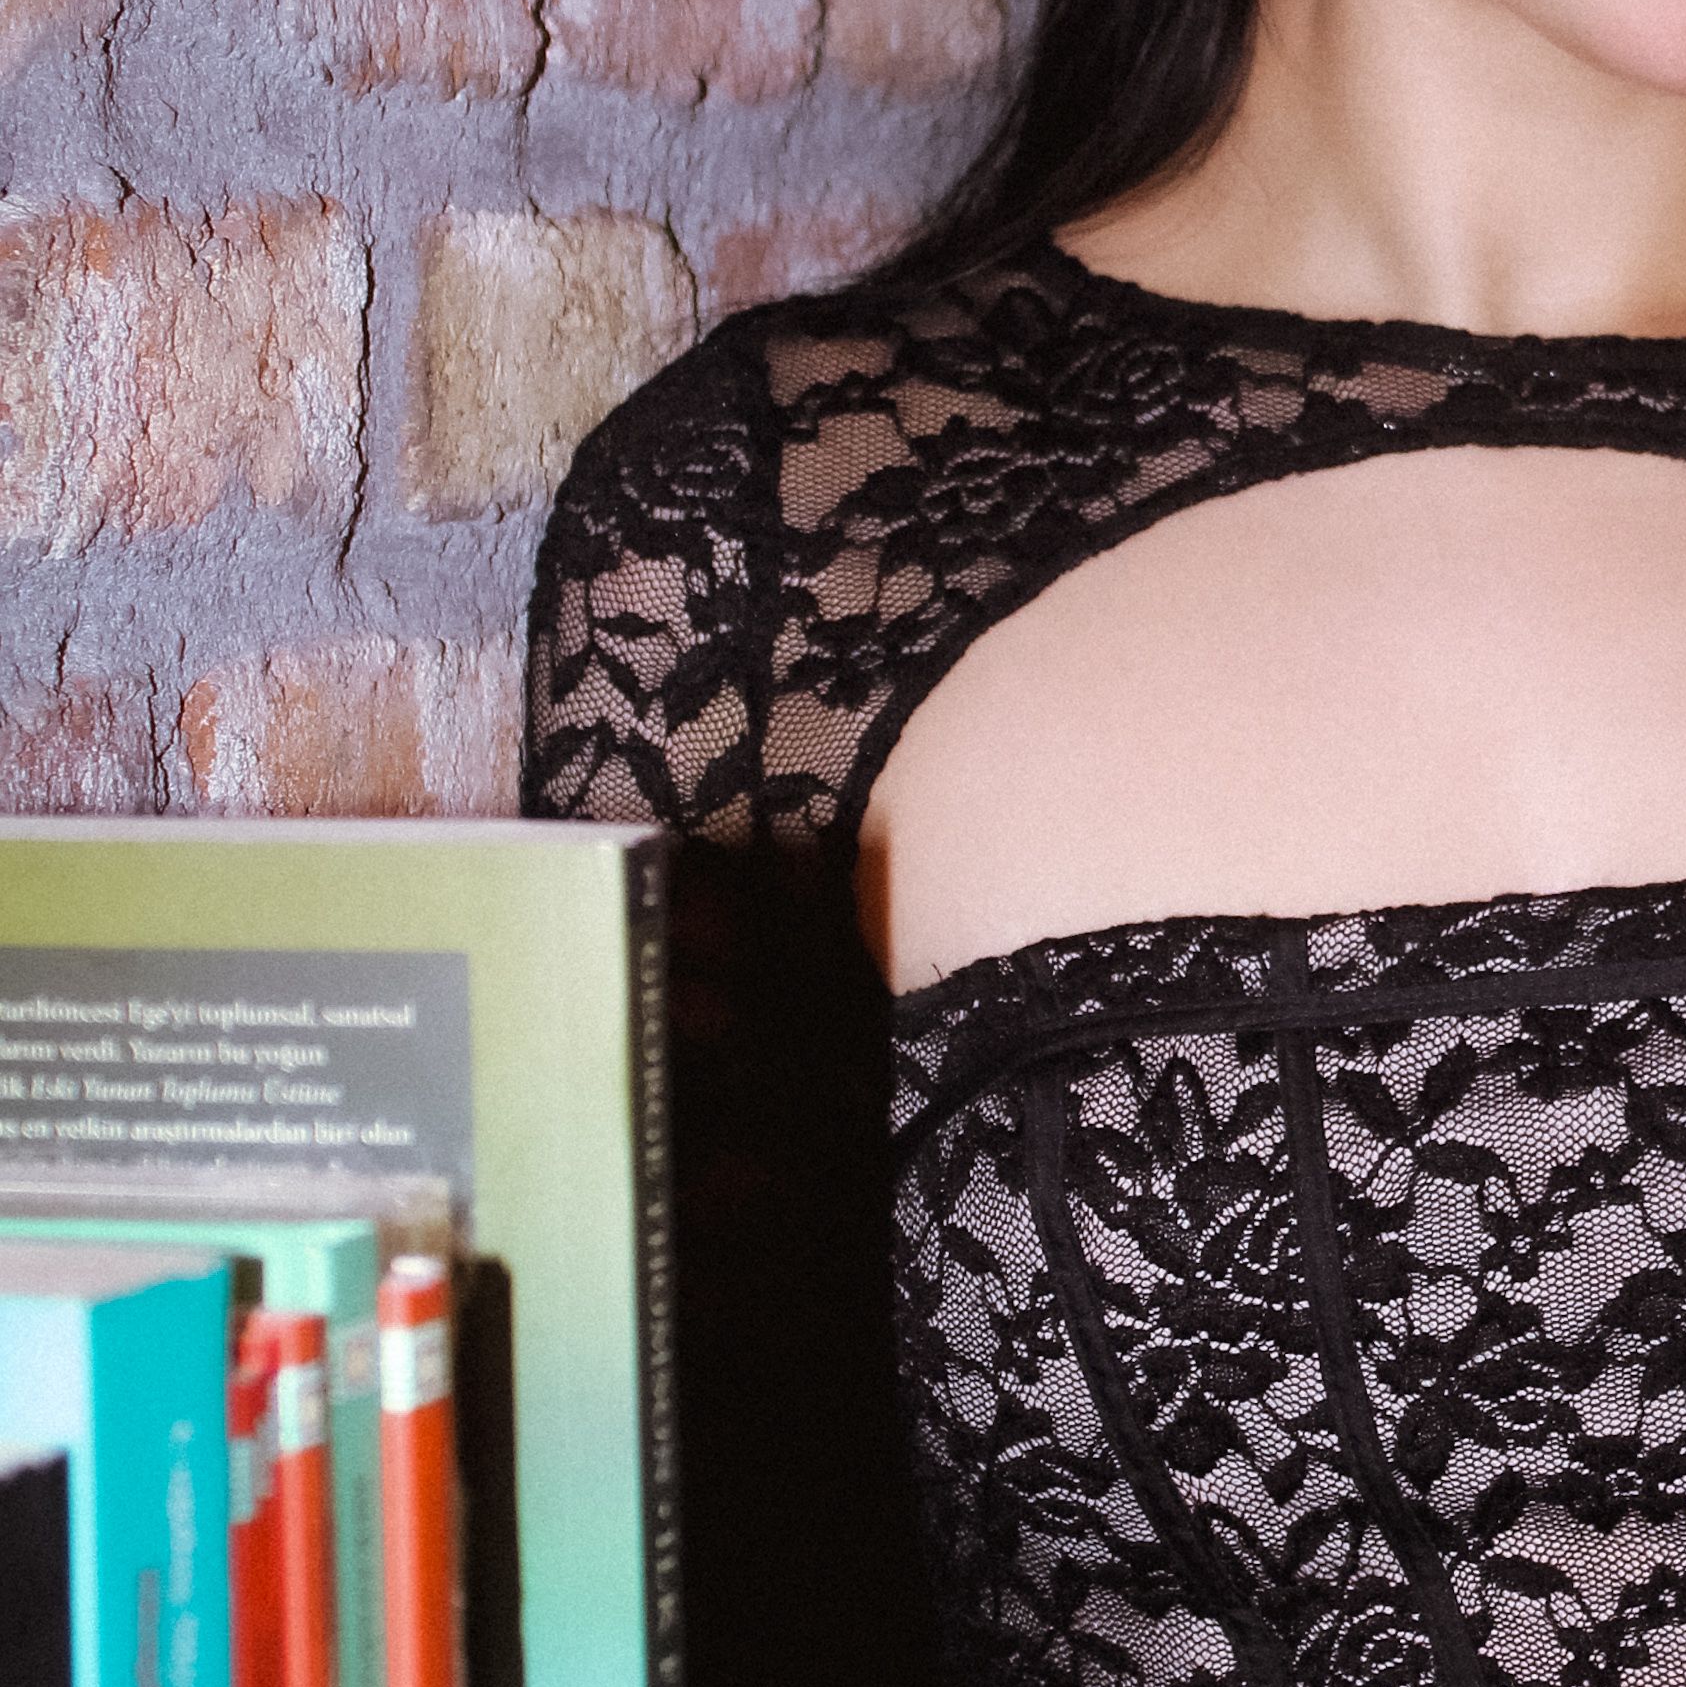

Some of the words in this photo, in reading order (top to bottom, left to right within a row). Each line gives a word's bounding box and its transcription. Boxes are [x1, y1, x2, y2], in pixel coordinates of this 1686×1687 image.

[0, 996, 122, 1023] arihöncesi
[319, 999, 415, 1028] sanatsal
[216, 1037, 249, 1064] bu
[360, 1118, 415, 1145] olan
